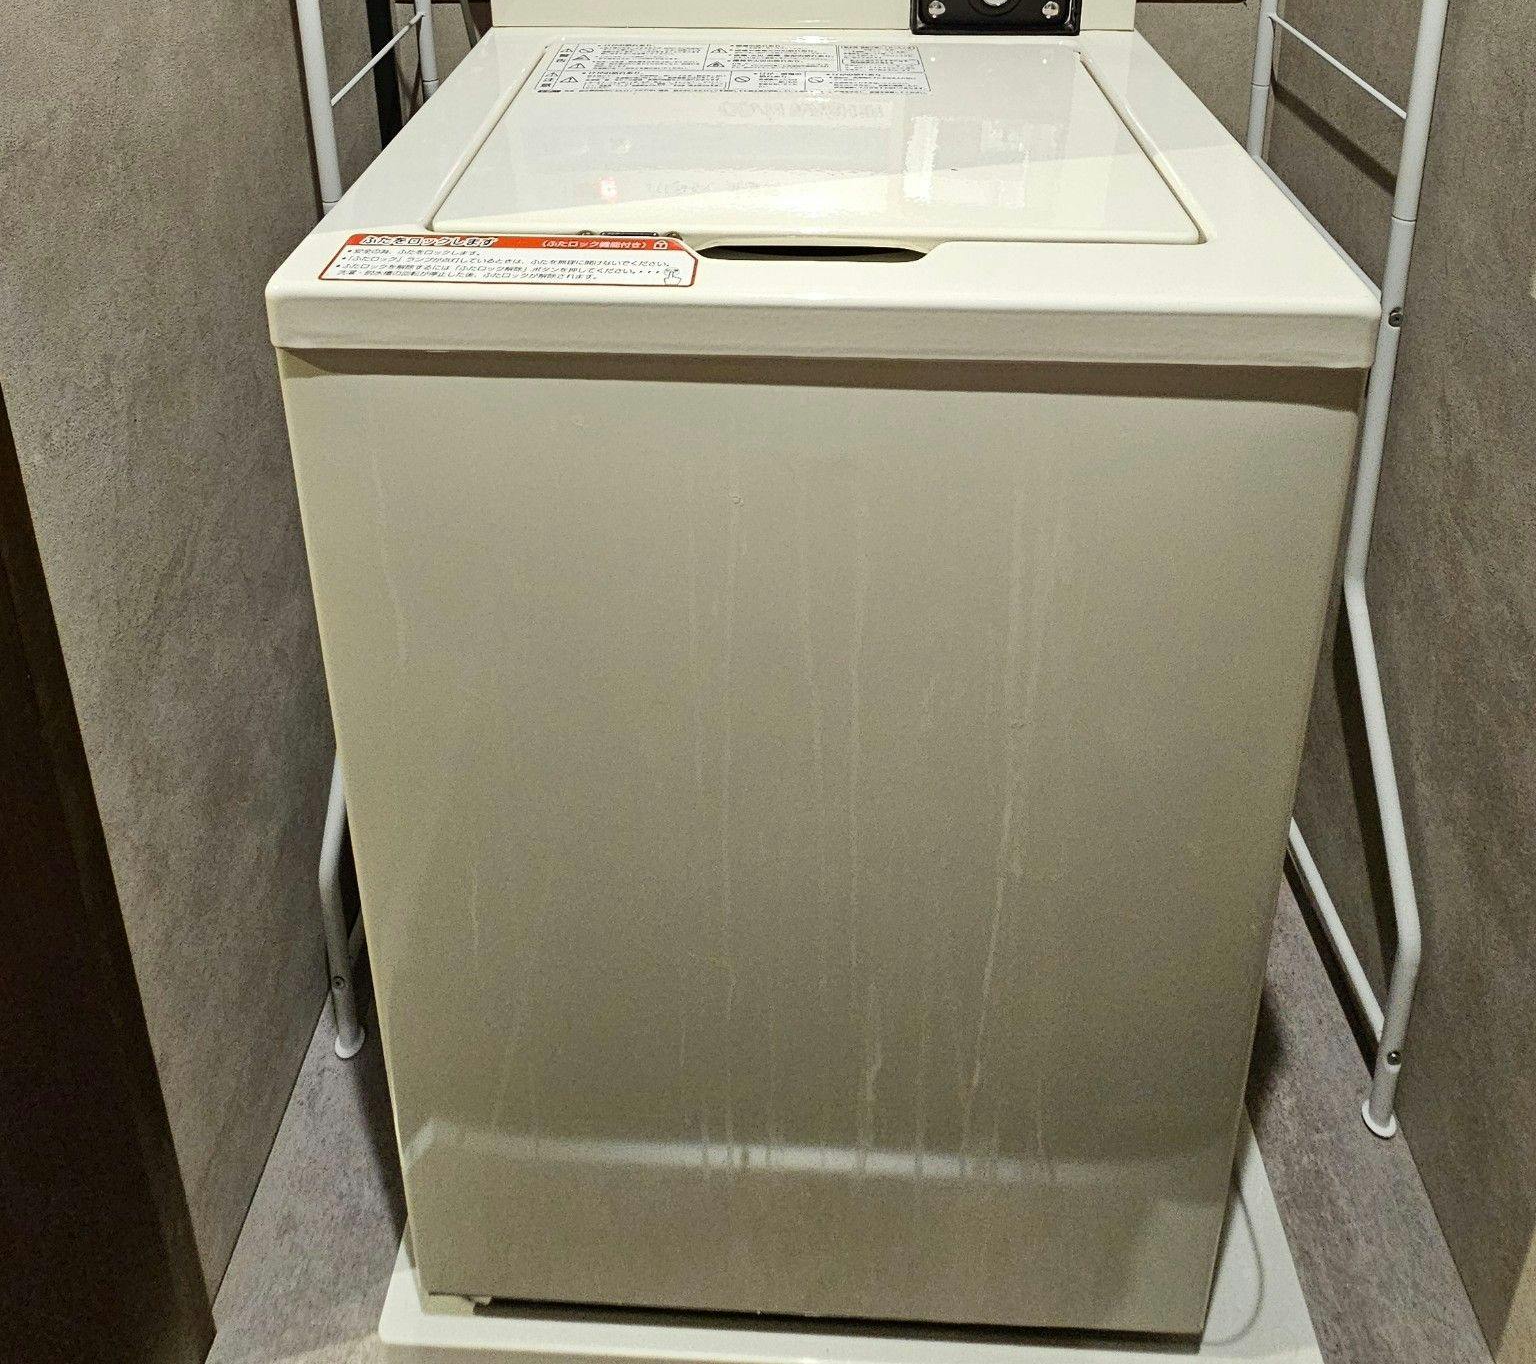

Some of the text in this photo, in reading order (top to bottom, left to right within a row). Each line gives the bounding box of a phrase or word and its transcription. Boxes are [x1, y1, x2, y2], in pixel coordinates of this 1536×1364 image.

[362, 236, 496, 246] ふたをロックします
